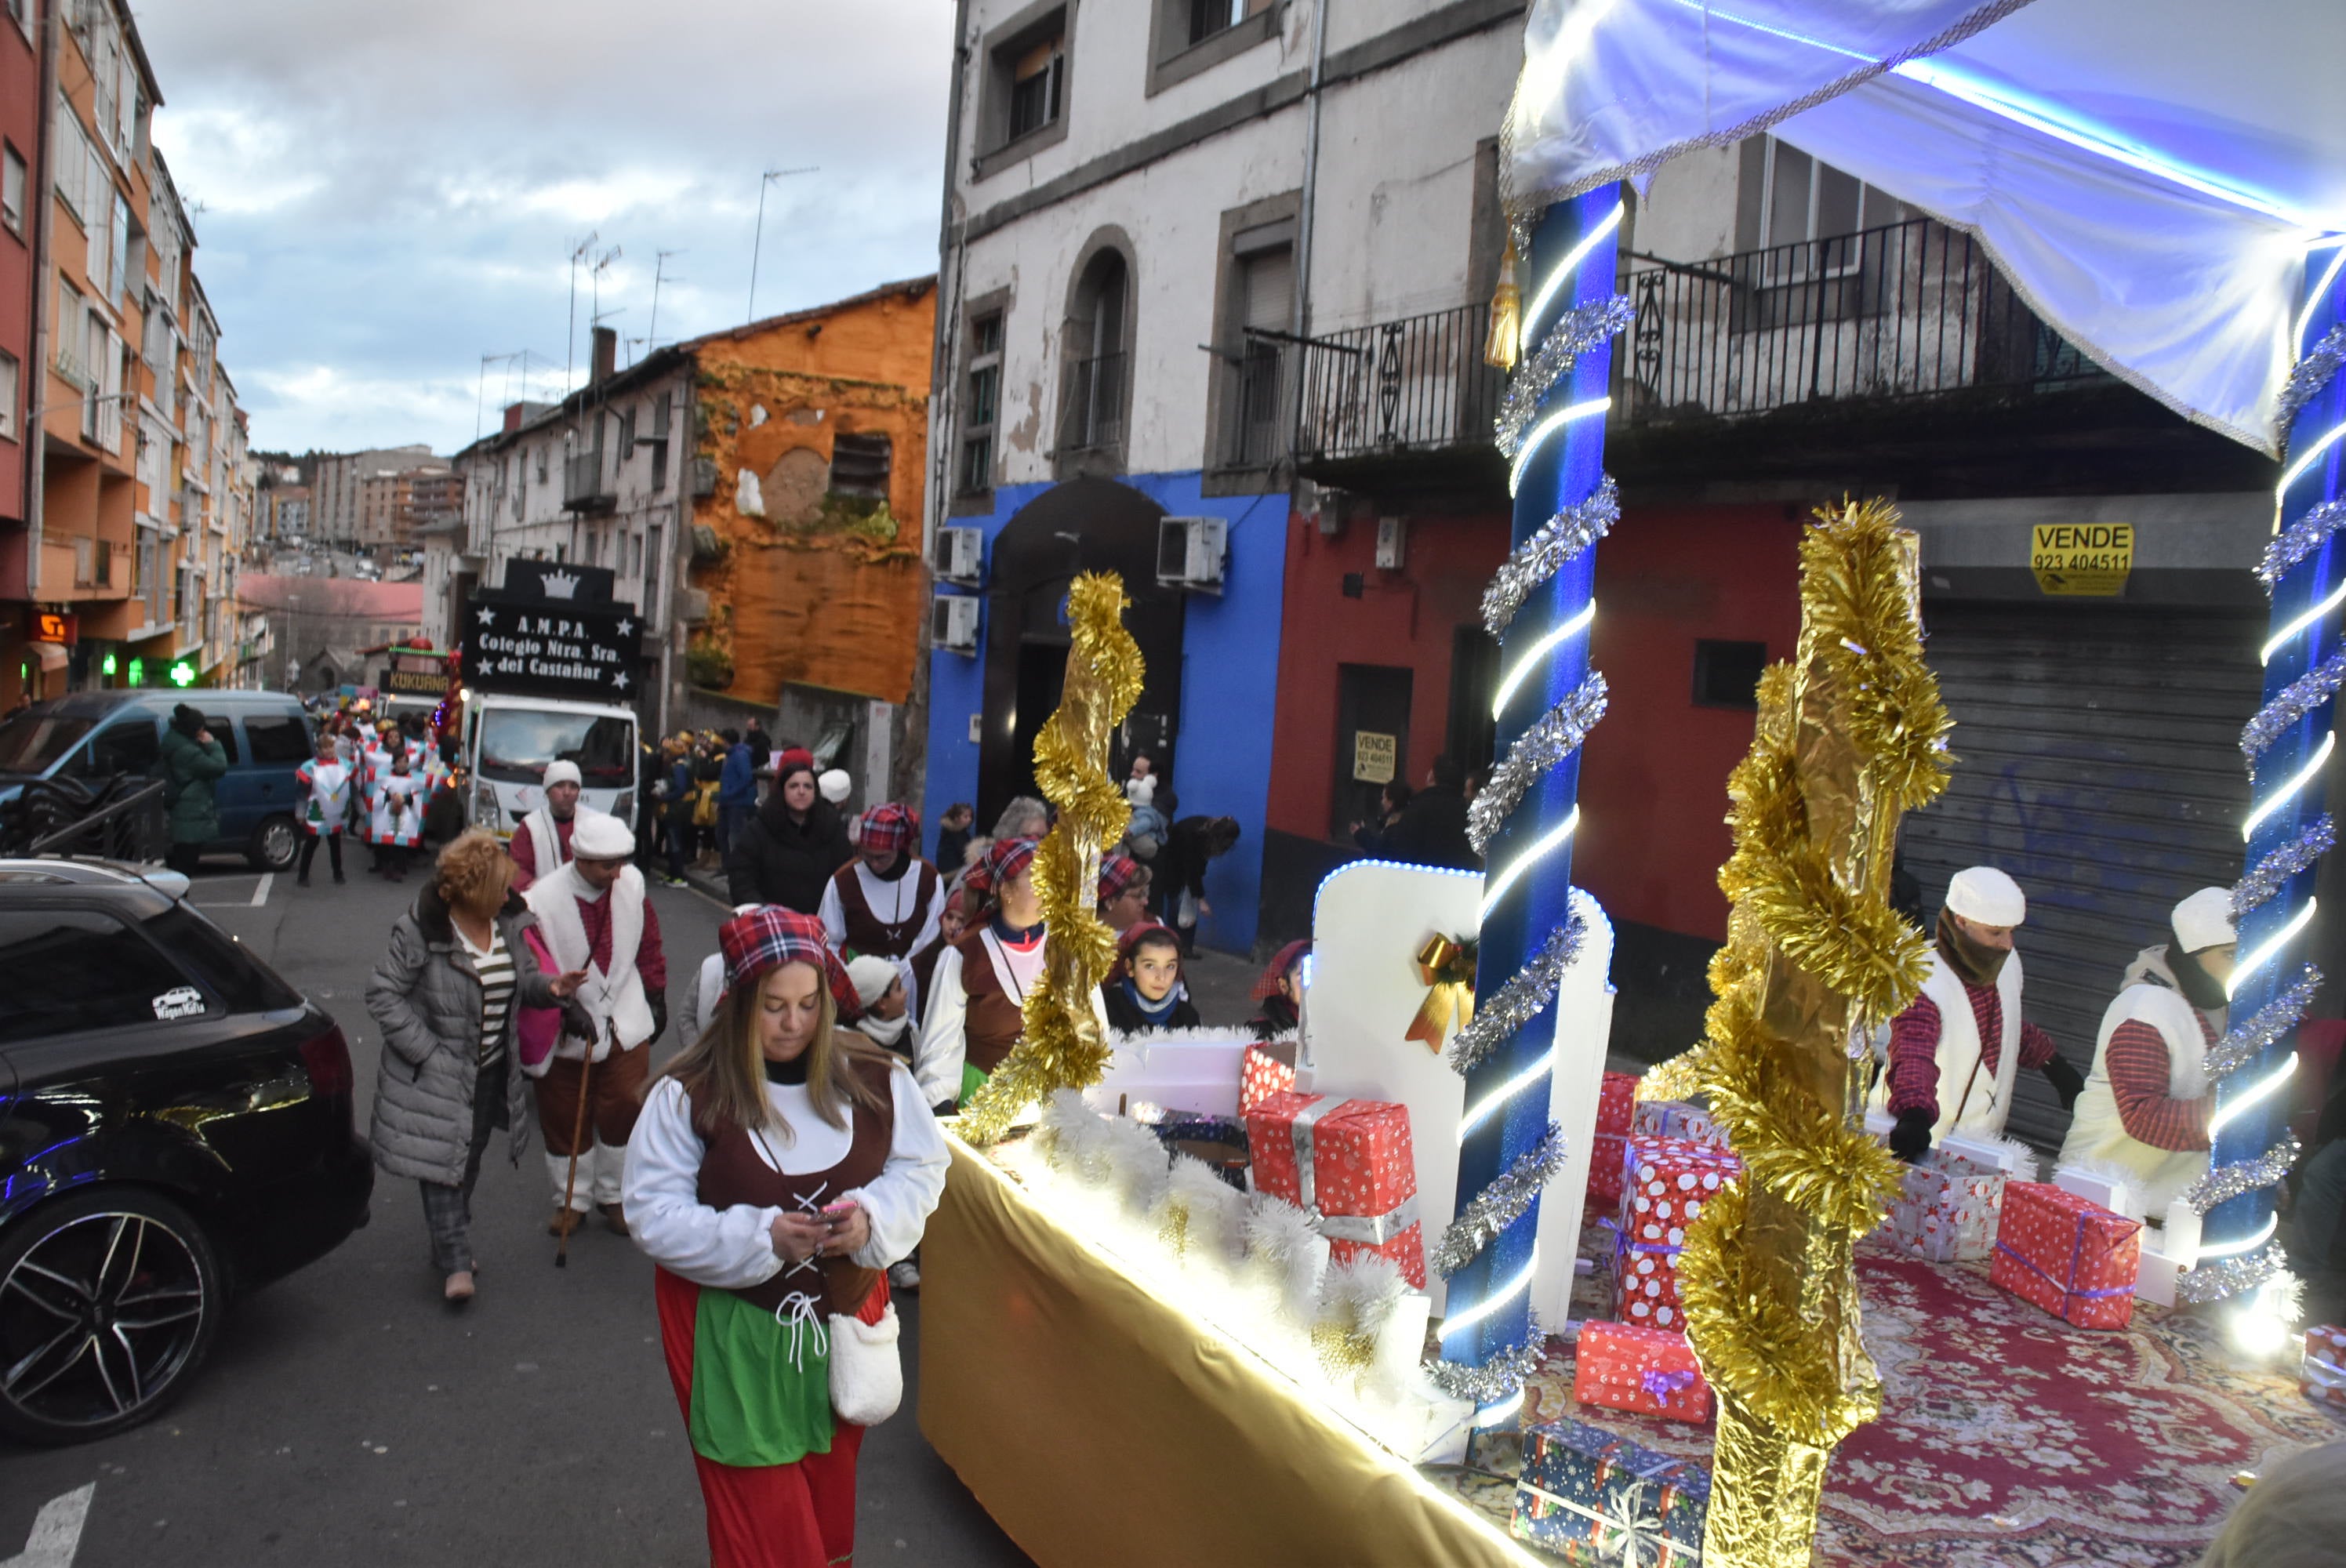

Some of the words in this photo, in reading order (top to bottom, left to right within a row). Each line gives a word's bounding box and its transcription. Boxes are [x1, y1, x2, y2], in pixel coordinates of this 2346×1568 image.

[2038, 527, 2129, 549] VENDE
[2034, 554, 2063, 572] 923
[2068, 554, 2128, 572] 404511
[518, 615, 590, 639] A.M.P.A.
[479, 632, 541, 656] Colegio
[547, 639, 584, 659] Ntra.
[591, 644, 621, 662] Sra.
[497, 656, 523, 673] del
[529, 657, 601, 681] Castañar
[390, 672, 449, 691] KUKUANA
[1357, 735, 1393, 753] VENDE
